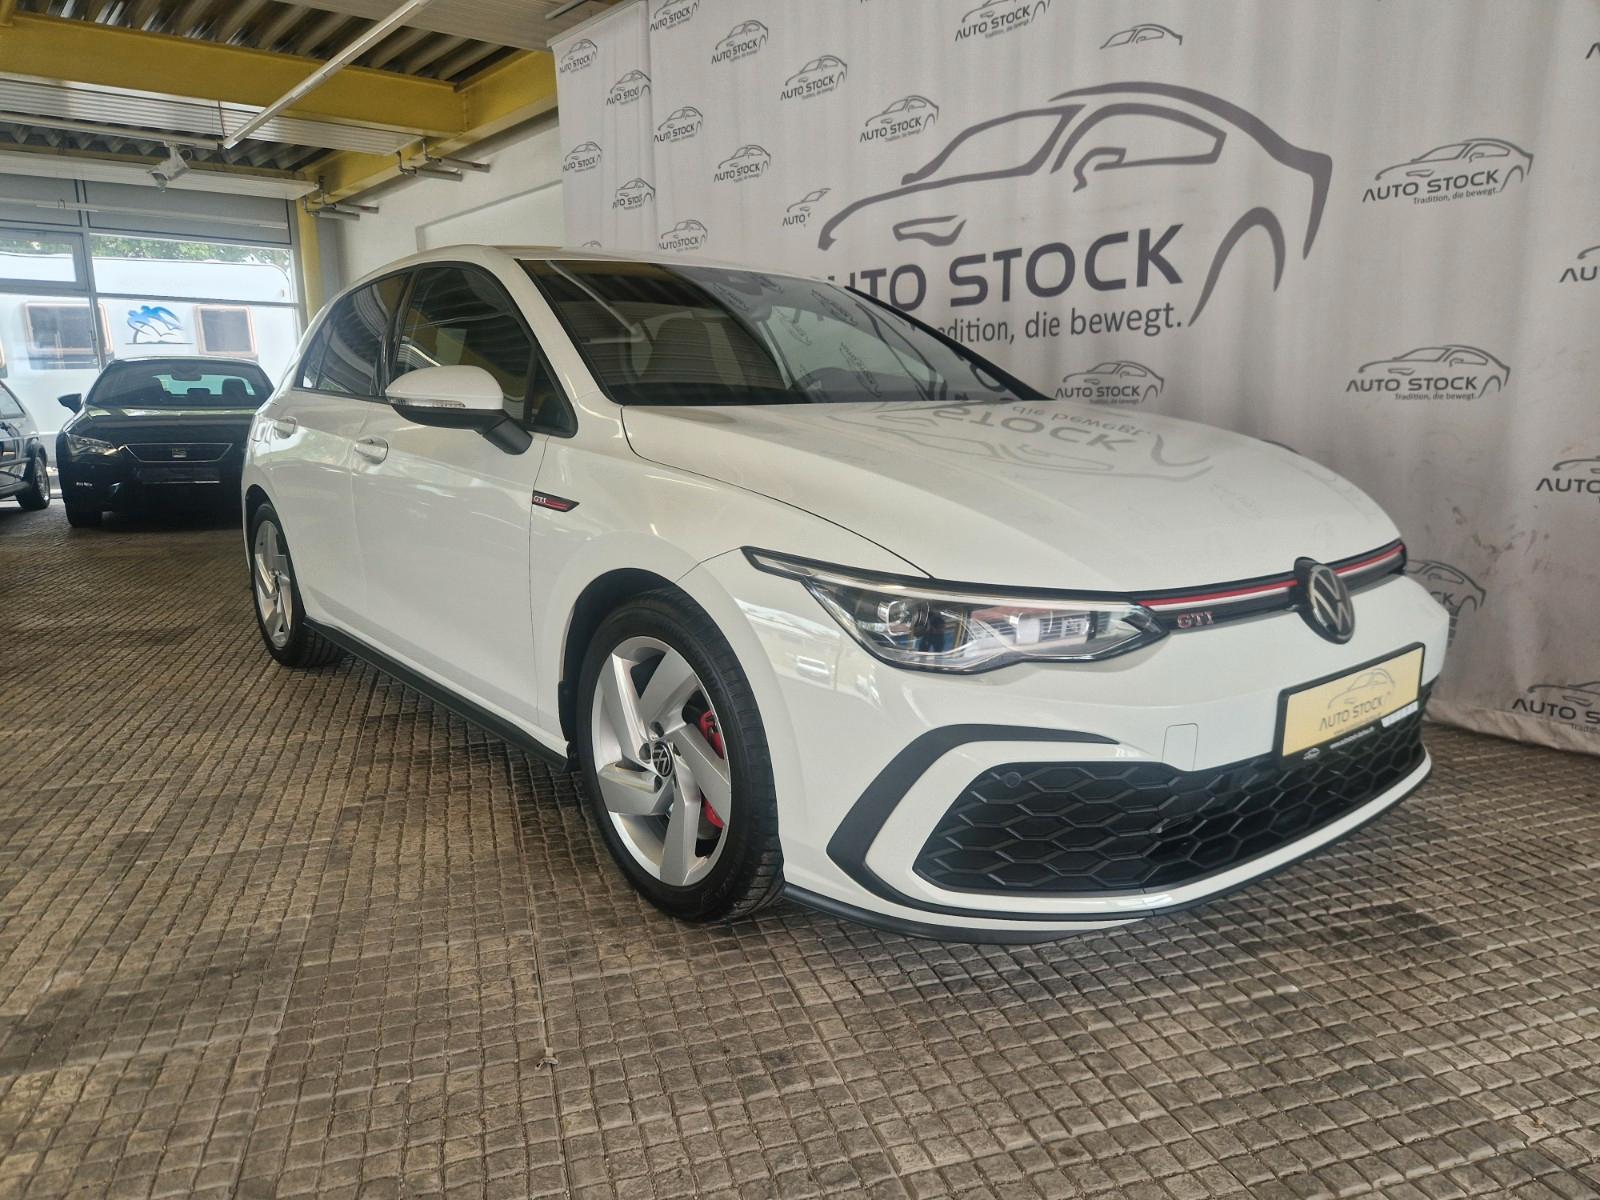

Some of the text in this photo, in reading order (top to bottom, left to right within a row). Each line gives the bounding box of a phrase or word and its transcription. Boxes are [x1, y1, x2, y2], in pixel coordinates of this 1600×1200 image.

[669, 6, 690, 24] STOCK
[955, 22, 988, 41] AUTO
[991, 5, 1030, 29] STOCK
[711, 49, 731, 64] AUTO
[732, 38, 758, 56] STOCK
[780, 86, 804, 101] AUTO
[806, 74, 835, 93] STOCK
[653, 131, 671, 142] AUTO
[673, 123, 695, 137] STOCK
[859, 127, 887, 143] AUTO
[890, 116, 922, 135] STOCK
[714, 169, 735, 183] AUTO
[737, 162, 760, 176] STOCK
[1362, 169, 1499, 203] AUTO STOCK
[782, 214, 806, 227] AUTO
[658, 239, 677, 250] AUTO
[677, 236, 699, 248] STOCK
[828, 263, 927, 312] TO
[949, 223, 1184, 307] STOCK
[1025, 311, 1060, 339] die
[1070, 302, 1182, 337] bewegt.
[1055, 385, 1140, 398] AUTO STOCK
[1346, 376, 1478, 392] AUTO STOCK
[1536, 478, 1600, 493] AUTO
[533, 496, 547, 504] GTI
[1177, 611, 1214, 629] GTI
[1319, 709, 1350, 732] AUTO
[1352, 697, 1383, 719] STOCK
[1512, 698, 1600, 724] AUTO S
